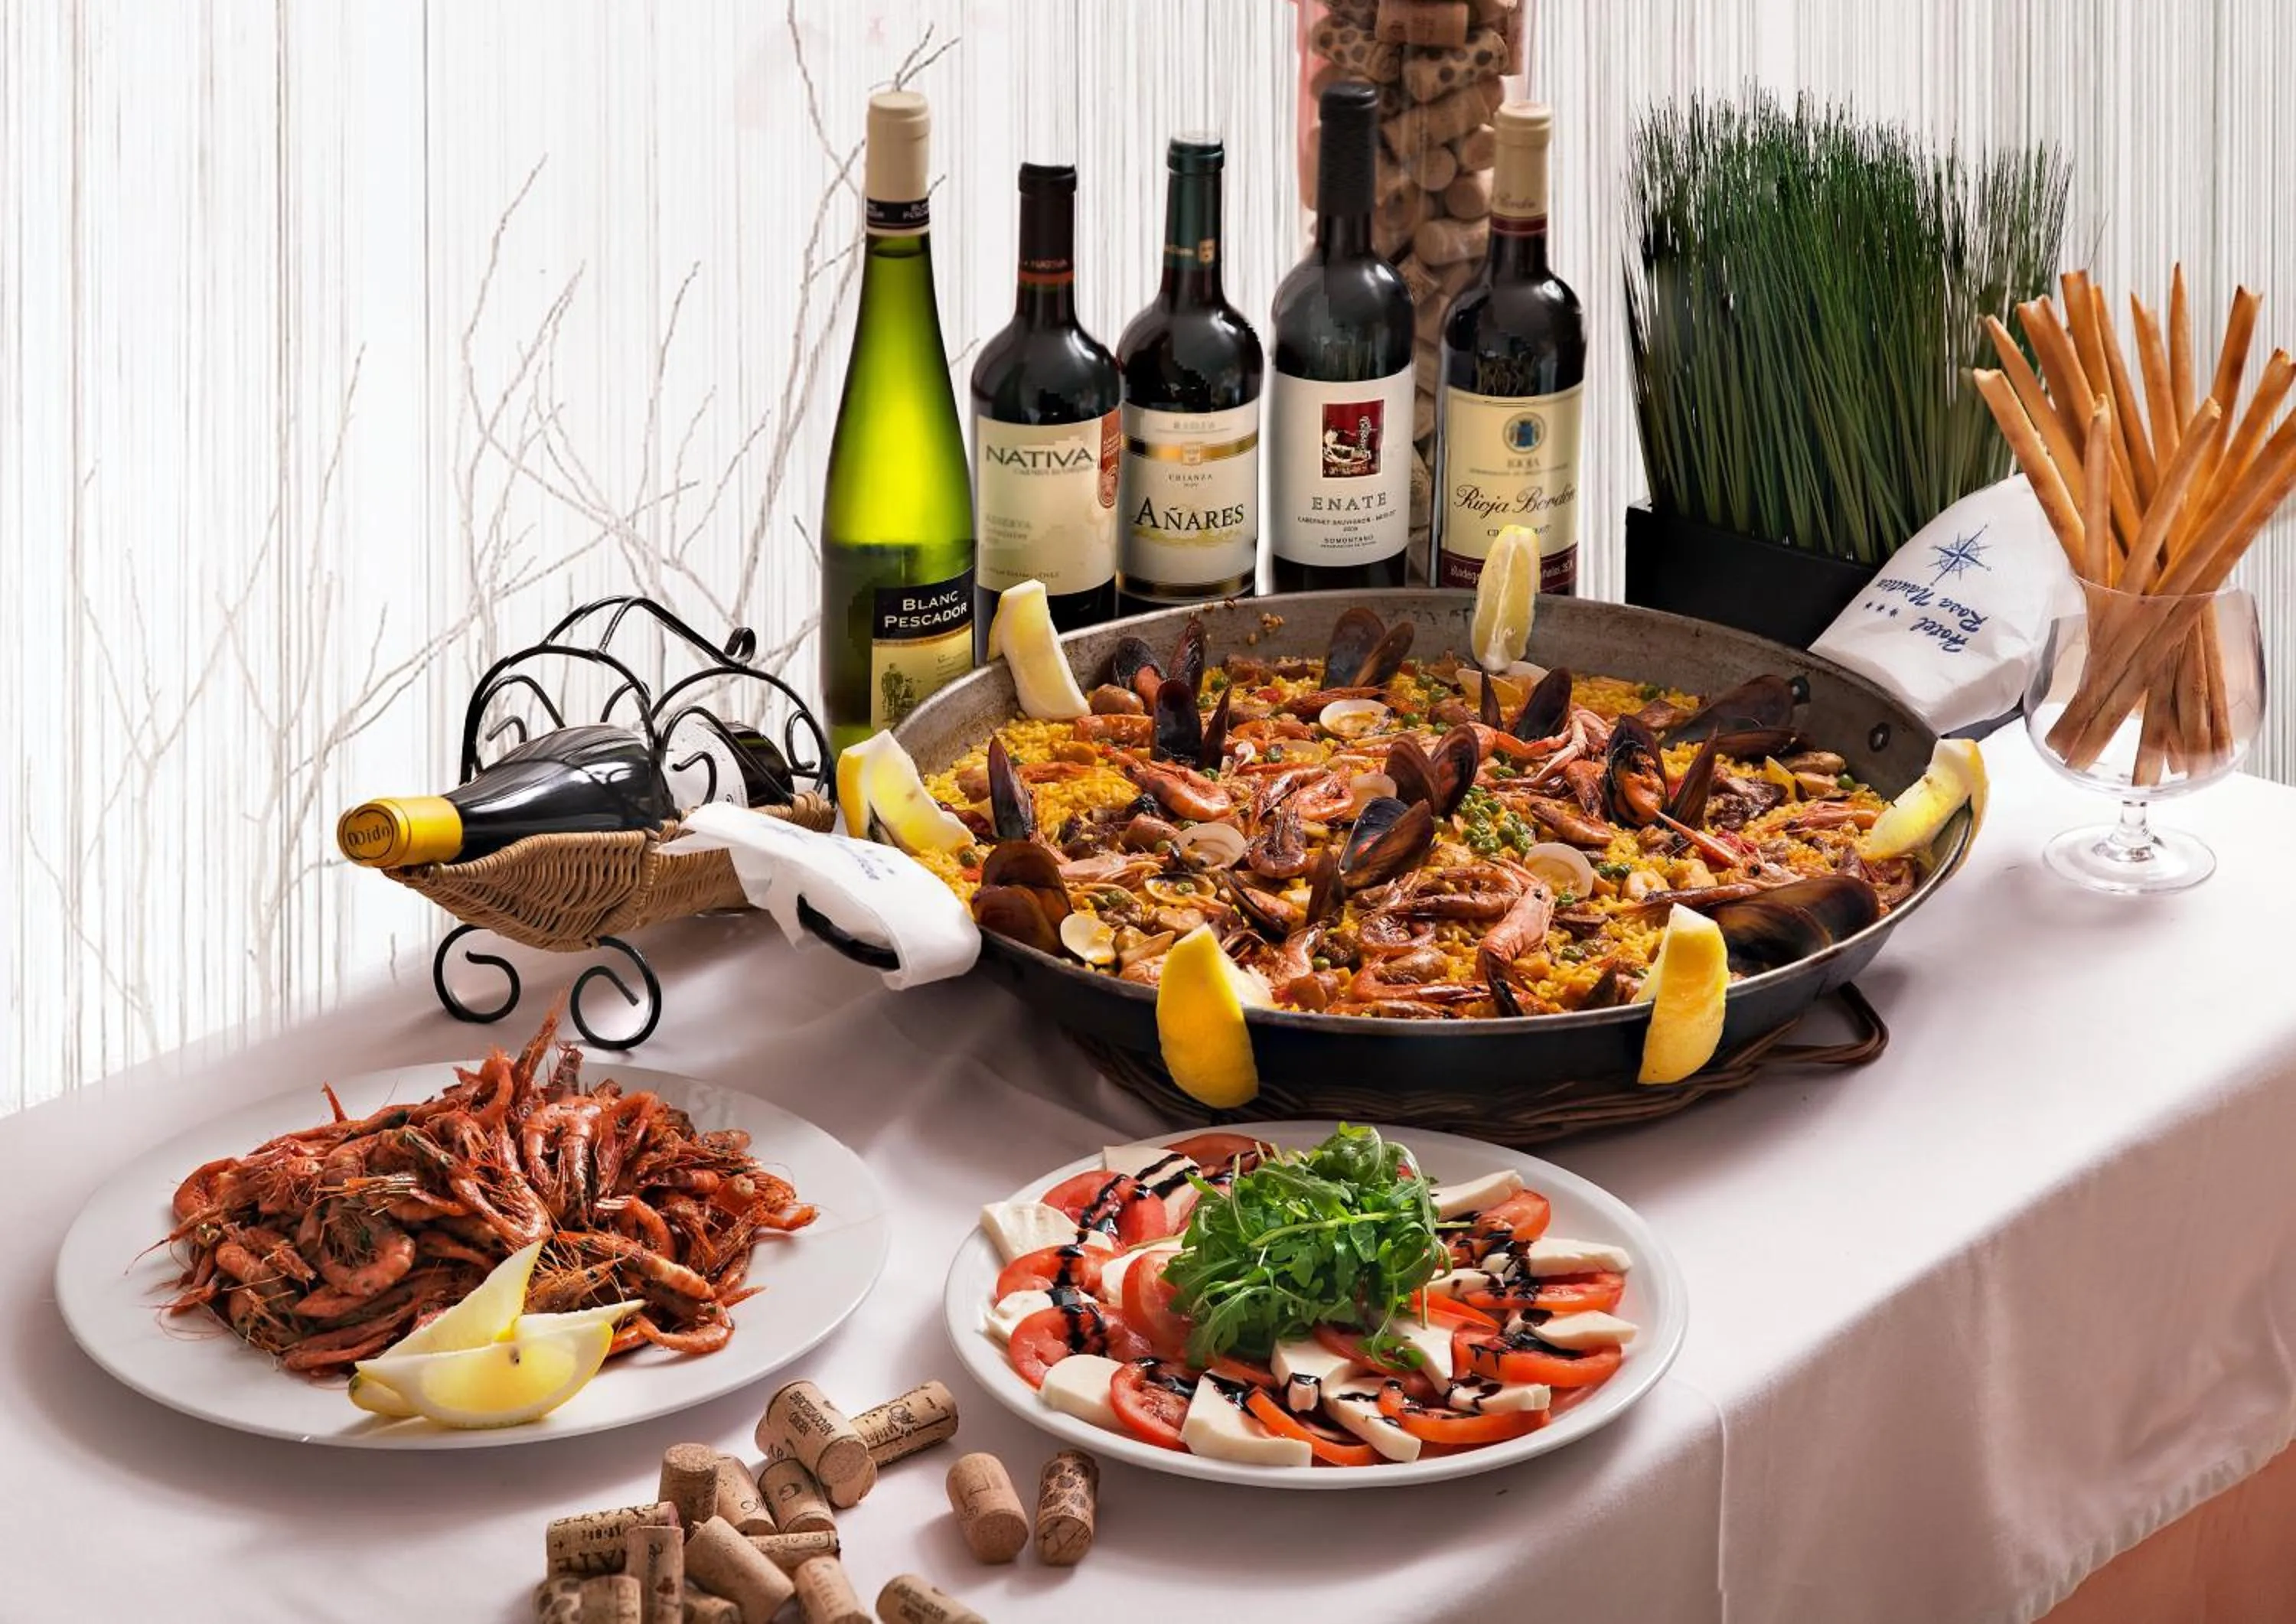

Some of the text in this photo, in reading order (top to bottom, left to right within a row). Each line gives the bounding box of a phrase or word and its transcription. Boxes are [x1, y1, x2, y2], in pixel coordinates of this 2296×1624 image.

[987, 445, 1093, 468] NATIVA
[1136, 497, 1244, 530] AÑARES
[1311, 491, 1387, 511] ENATE
[1454, 484, 1510, 520] Rioja
[884, 602, 967, 628] PESCADOR
[902, 590, 958, 611] BLANC
[1937, 597, 1989, 634] Rosa
[1910, 617, 1970, 653] Hotel
